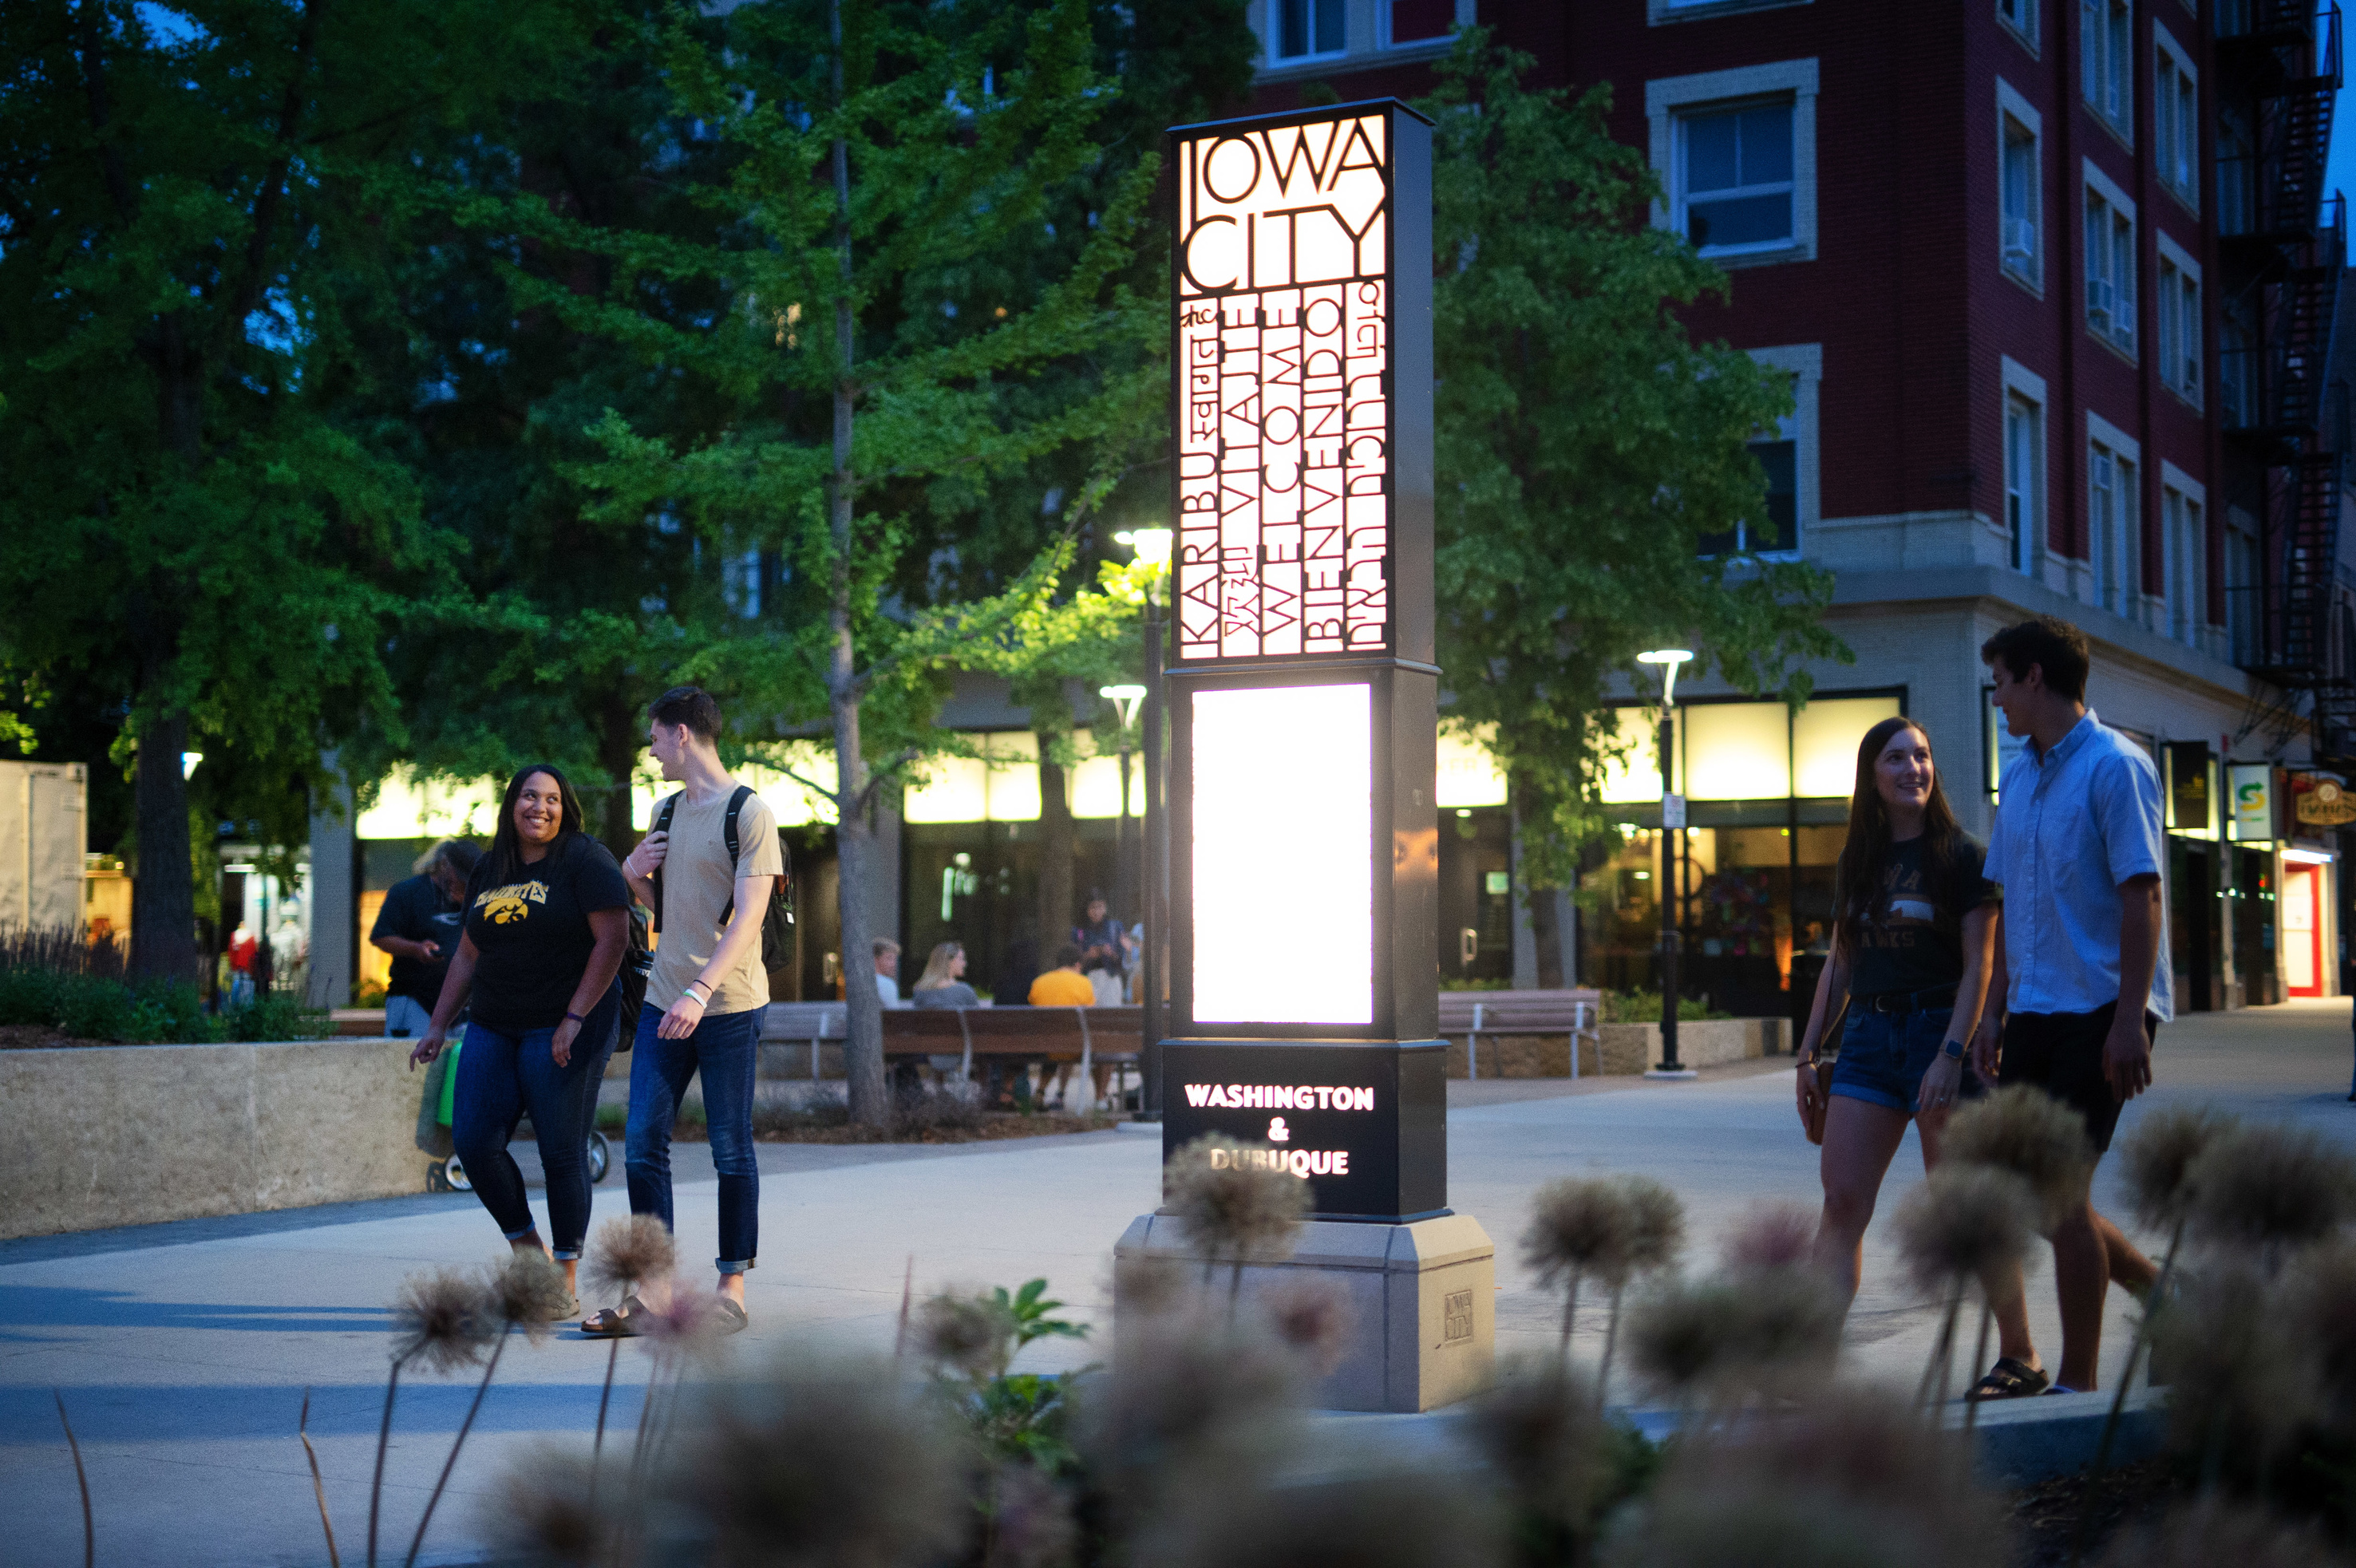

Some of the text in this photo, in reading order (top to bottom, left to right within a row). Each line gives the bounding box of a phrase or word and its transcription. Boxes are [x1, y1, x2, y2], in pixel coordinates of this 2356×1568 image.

[1187, 116, 1386, 230] IOWA
[1180, 196, 1386, 294] CITY
[1182, 304, 1218, 444] स्वागत है
[1346, 281, 1386, 360] مرحبا
[1221, 307, 1259, 517] VITAJTE
[1262, 306, 1300, 637] WELCOME
[1303, 298, 1342, 639] BIENVENIDO
[1181, 452, 1218, 644] KARIBU
[1346, 369, 1386, 645] ברוכים הבאים
[1221, 544, 1259, 637] 欢迎
[1184, 1084, 1374, 1111] WASHINGTON
[1267, 1116, 1290, 1141] &
